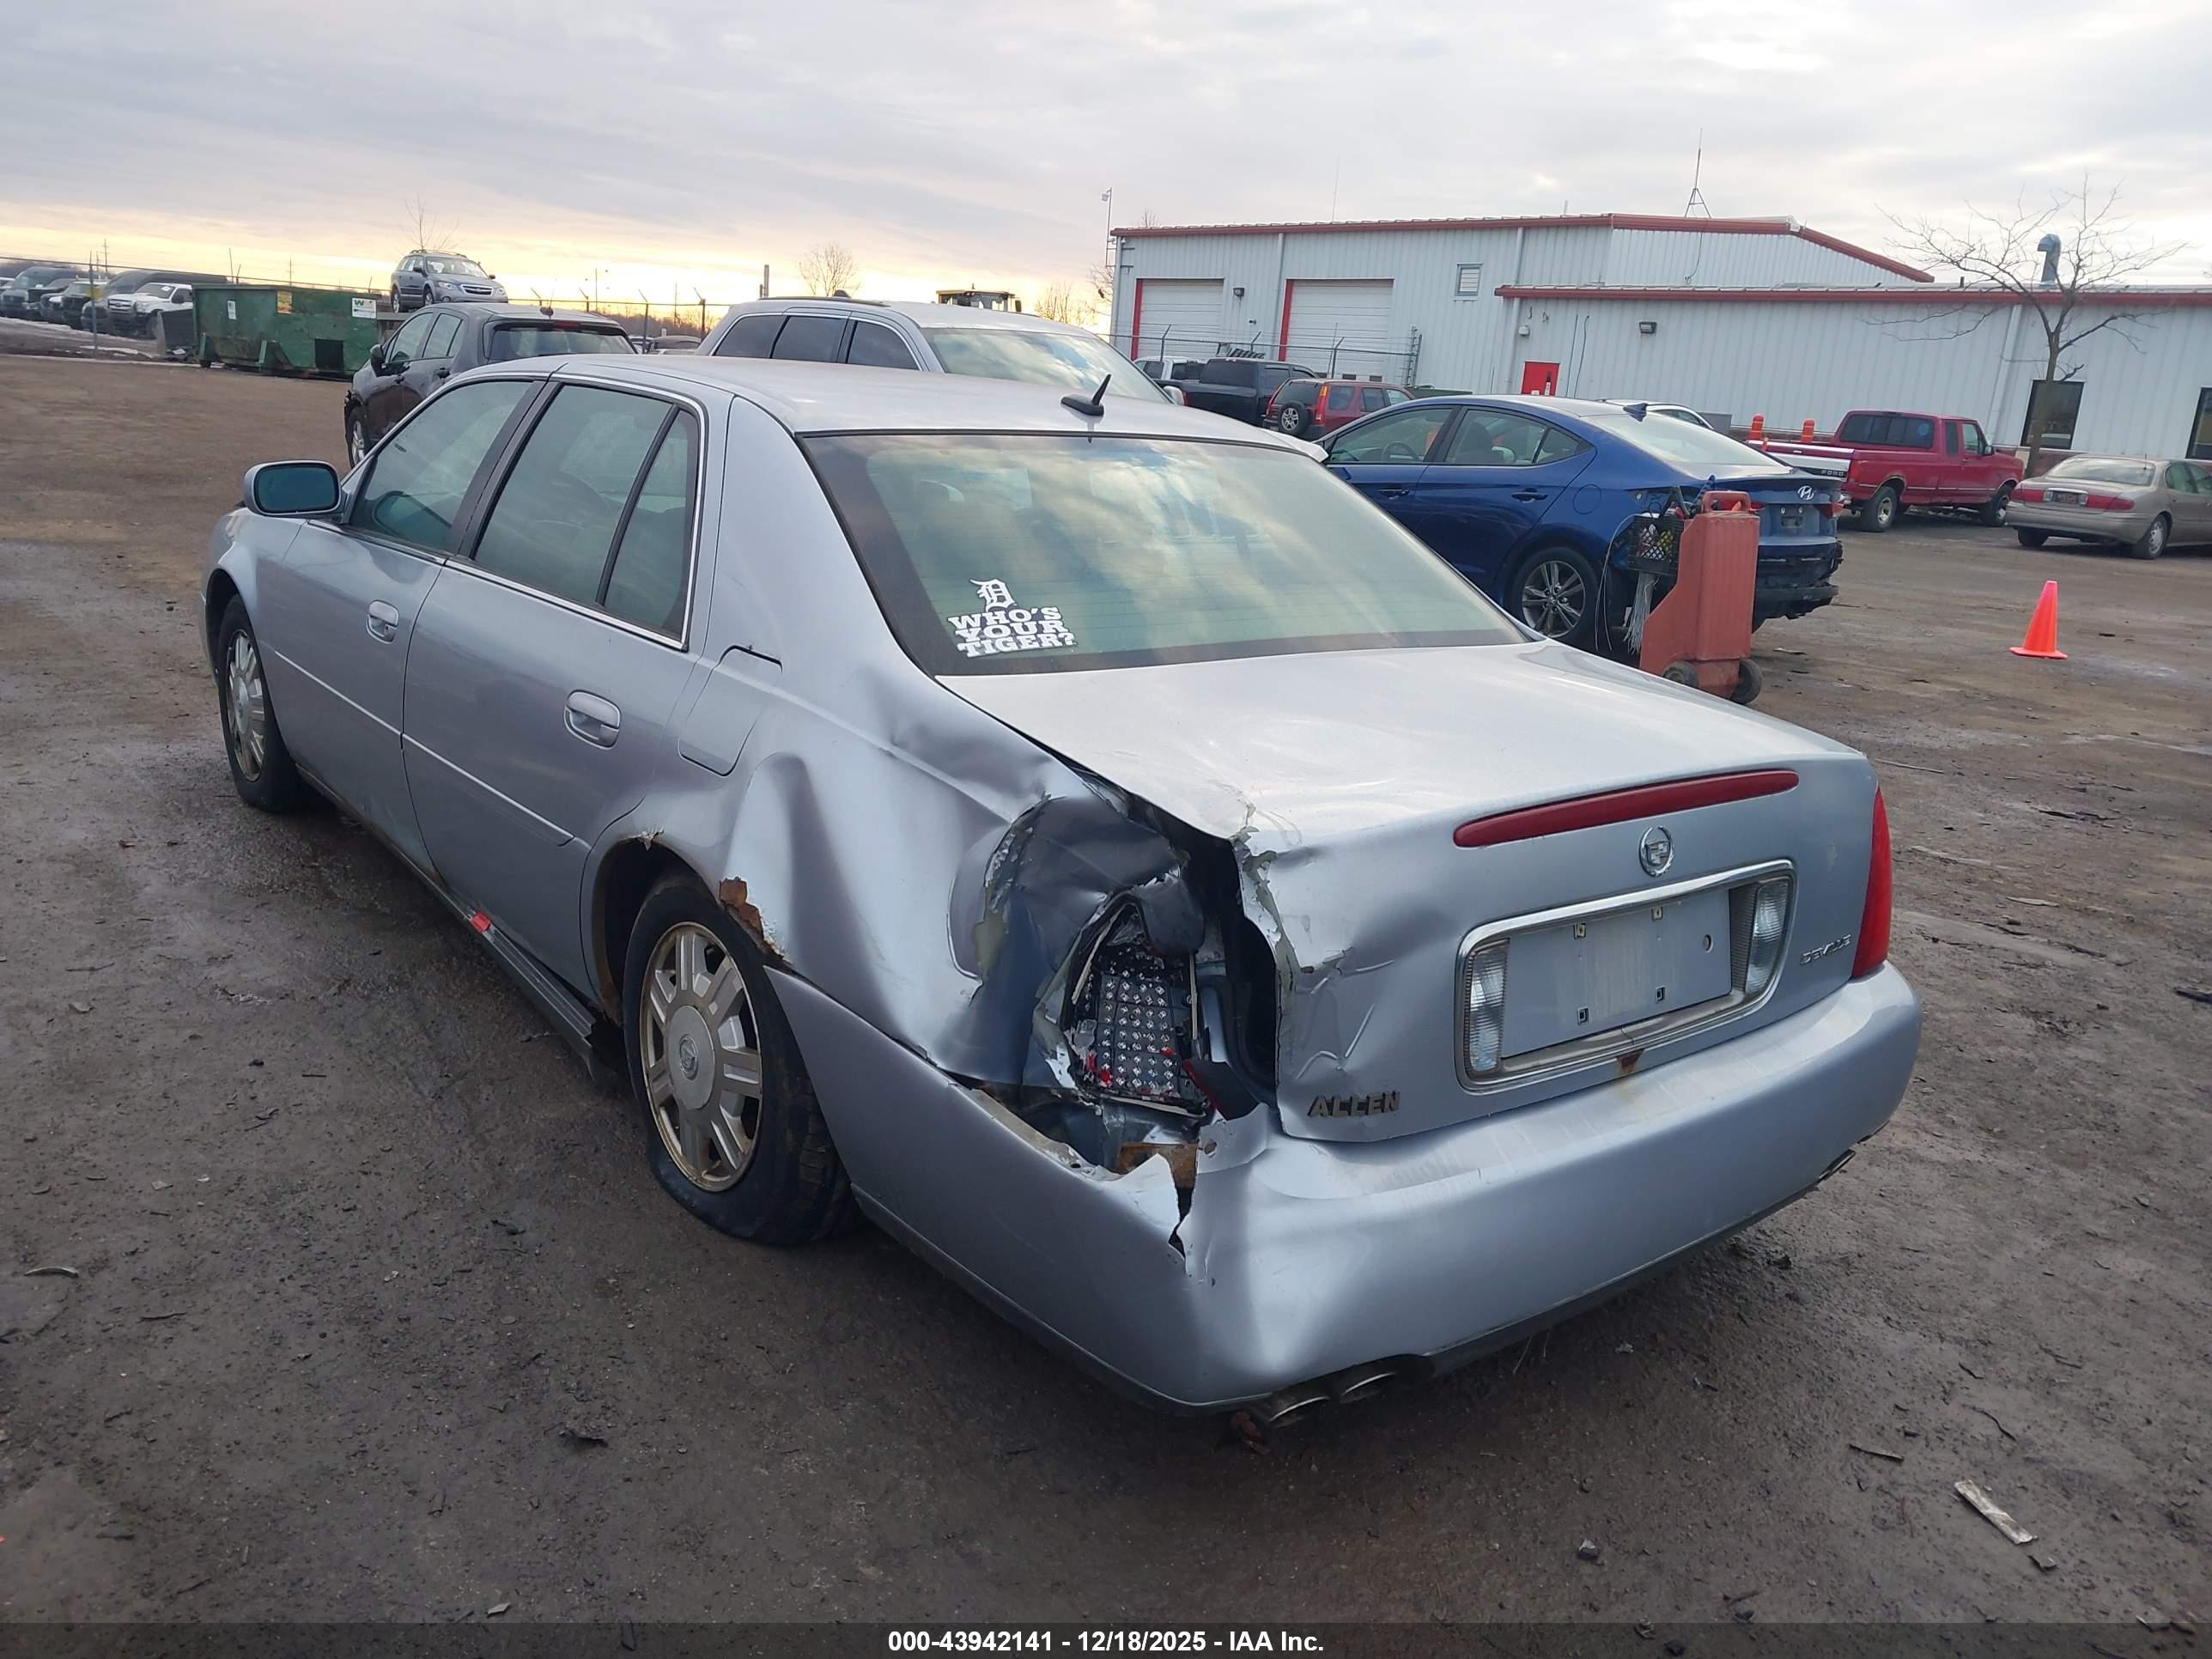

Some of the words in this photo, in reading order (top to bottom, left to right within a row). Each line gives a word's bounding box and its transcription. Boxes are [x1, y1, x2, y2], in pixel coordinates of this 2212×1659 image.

[947, 605, 1062, 630] WHO'S
[954, 619, 1069, 643] YOUR
[956, 632, 1076, 659] TIGER?
[1308, 1090, 1401, 1118] ALLEN
